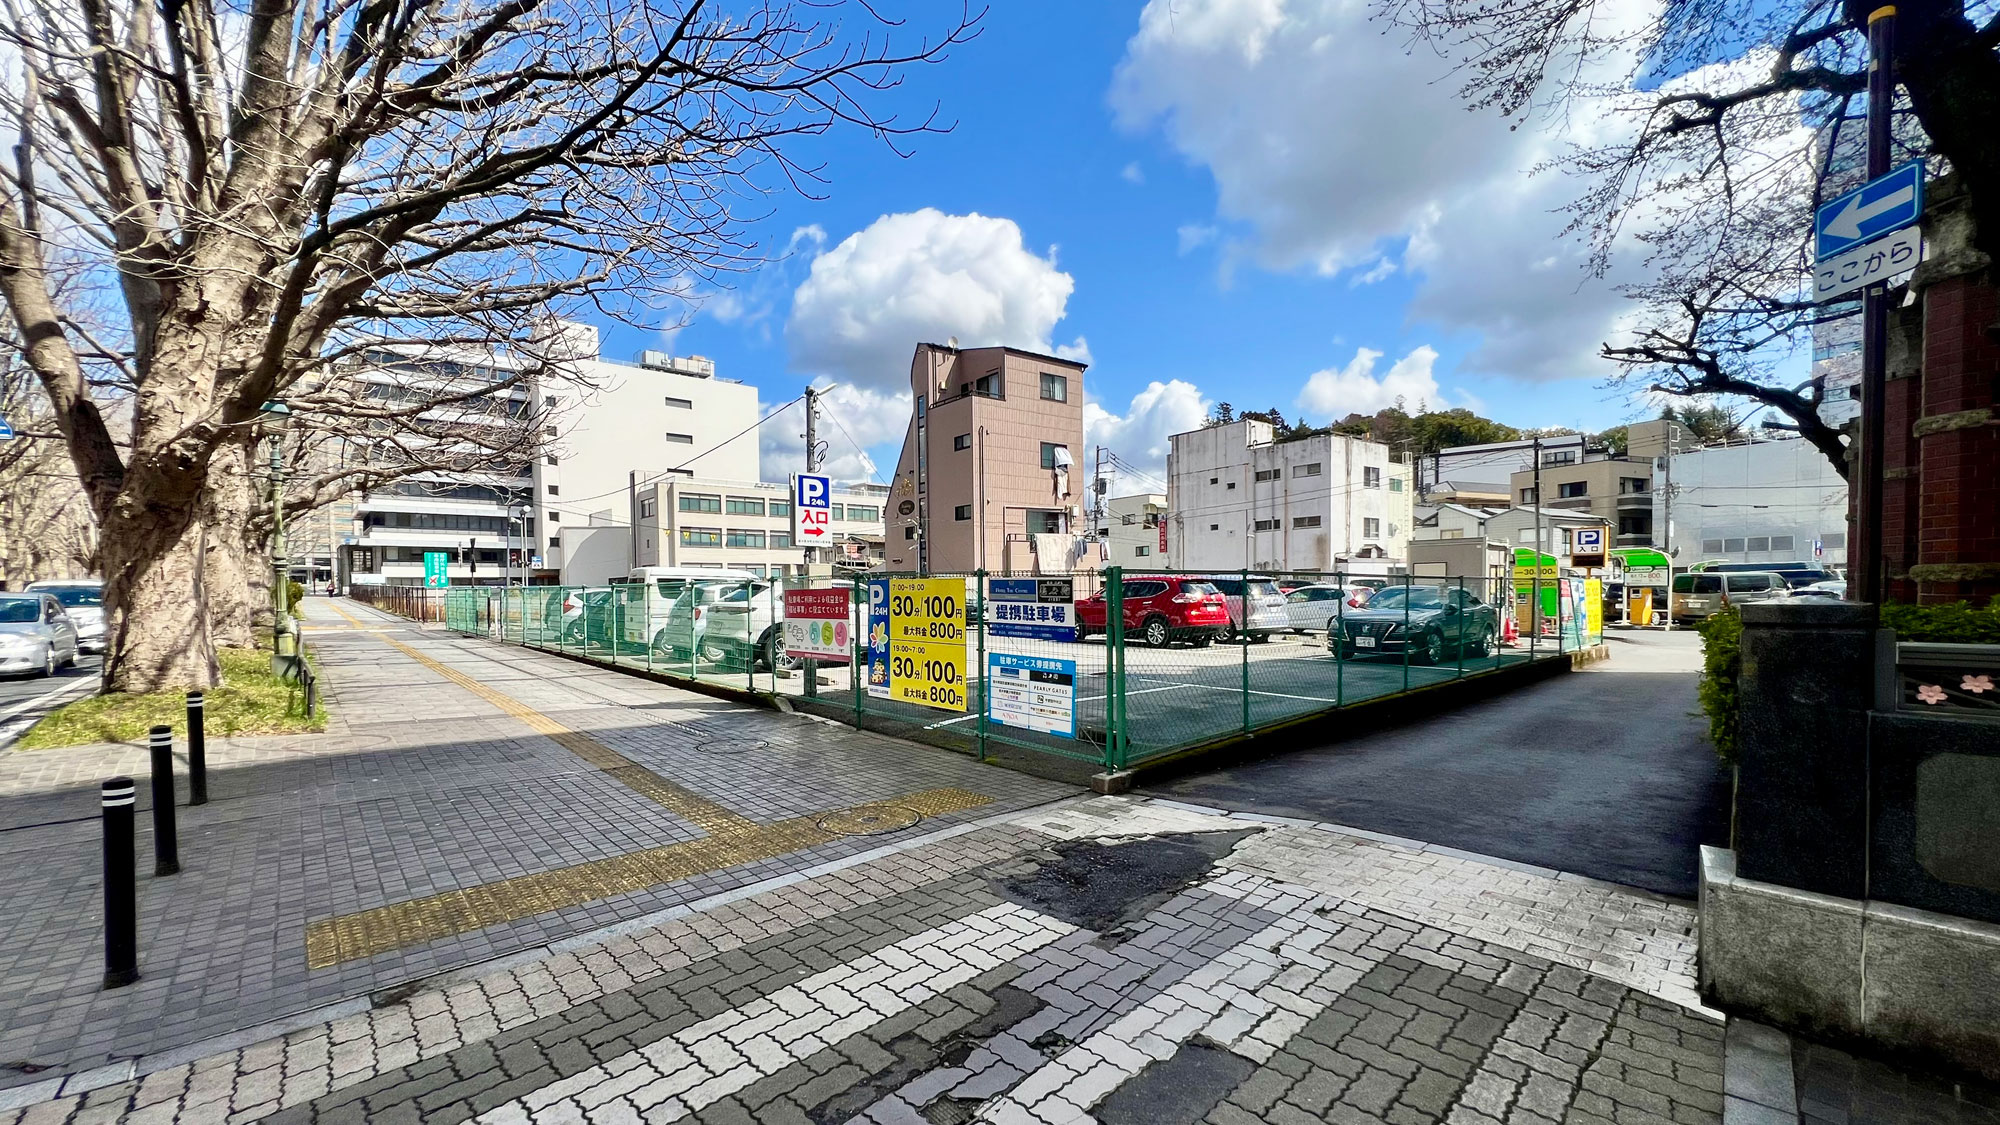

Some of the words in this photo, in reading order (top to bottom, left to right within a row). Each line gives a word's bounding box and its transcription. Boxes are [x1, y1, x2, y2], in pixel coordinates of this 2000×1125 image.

[1818, 241, 1913, 292] ここから
[802, 478, 824, 505] P
[811, 498, 826, 506] 24h
[801, 509, 828, 524] 入口
[1580, 531, 1598, 545] P
[869, 584, 884, 615] P
[875, 607, 888, 616] 24H
[995, 604, 1065, 622] 提携駐車場
[903, 626, 928, 637] 最大料金
[929, 622, 963, 640] 800円
[903, 687, 928, 700] 最大料金
[930, 685, 963, 706] 800円
[1033, 685, 1051, 693] PEARLY
